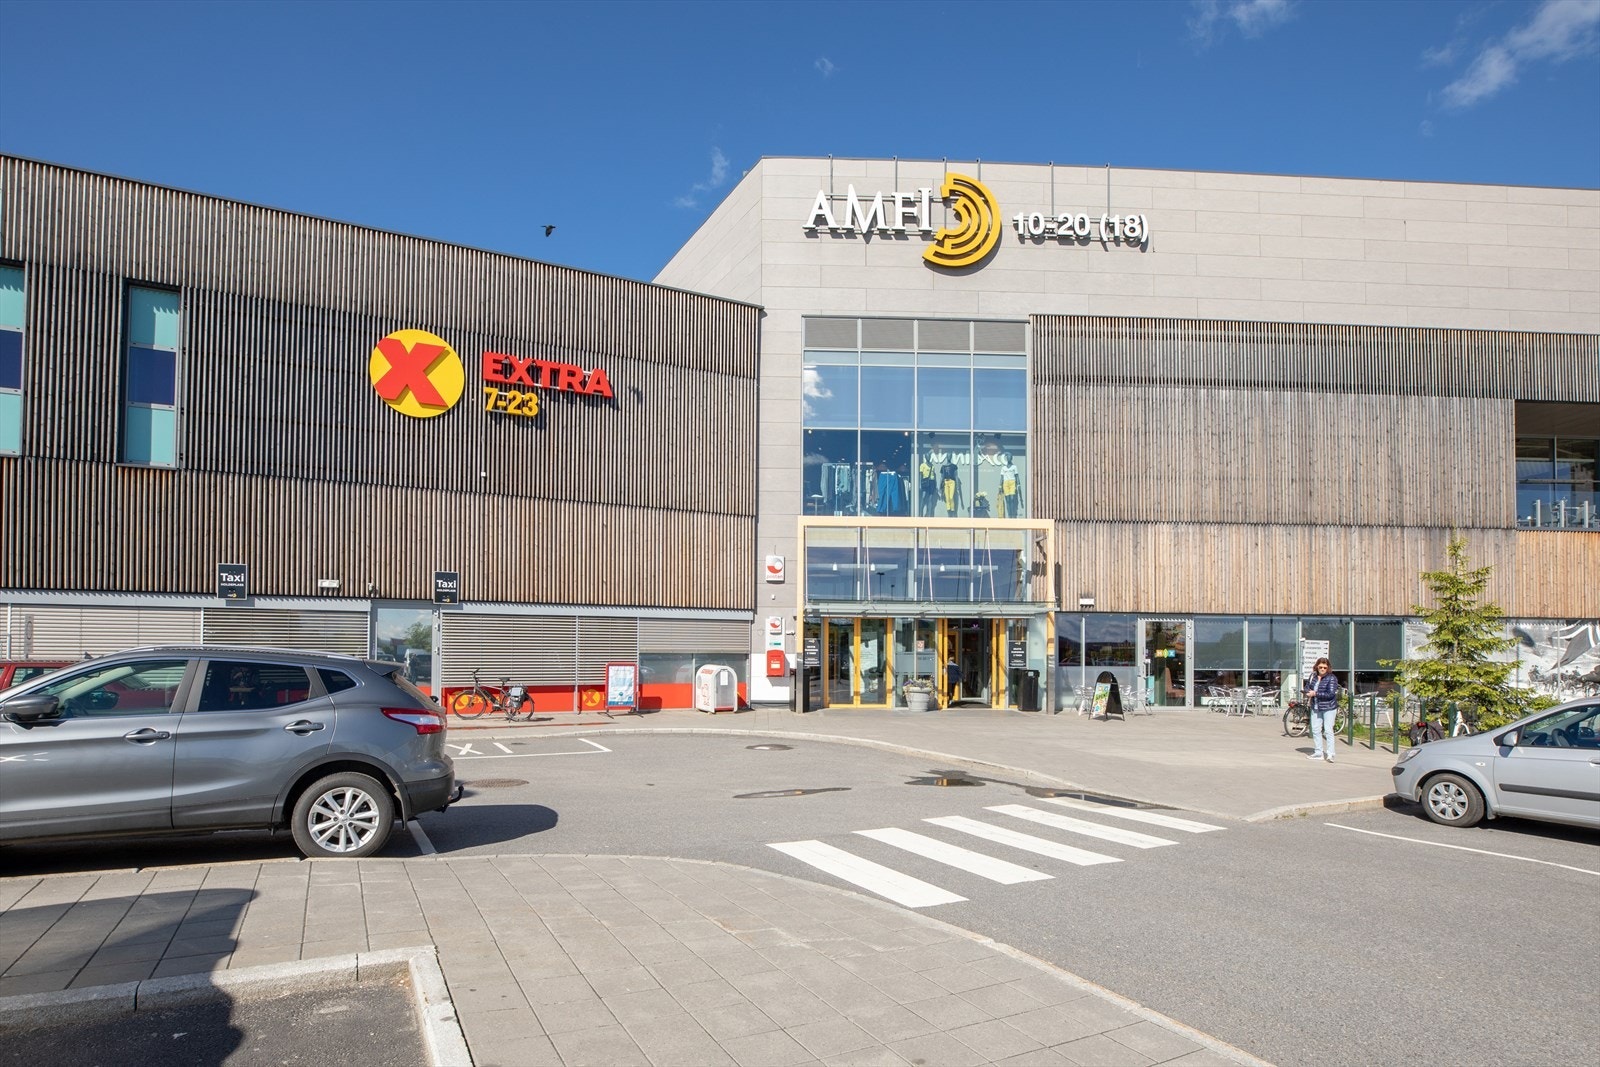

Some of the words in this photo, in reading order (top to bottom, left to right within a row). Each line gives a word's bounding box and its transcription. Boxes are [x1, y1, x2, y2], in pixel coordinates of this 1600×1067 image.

[802, 184, 933, 234] AMFI
[1013, 212, 1091, 237] 10-20
[1099, 213, 1149, 243] (18)
[482, 351, 613, 398] EXTRA
[484, 386, 540, 418] 7-23
[220, 572, 245, 582] Taxi
[436, 579, 457, 589] Taxi
